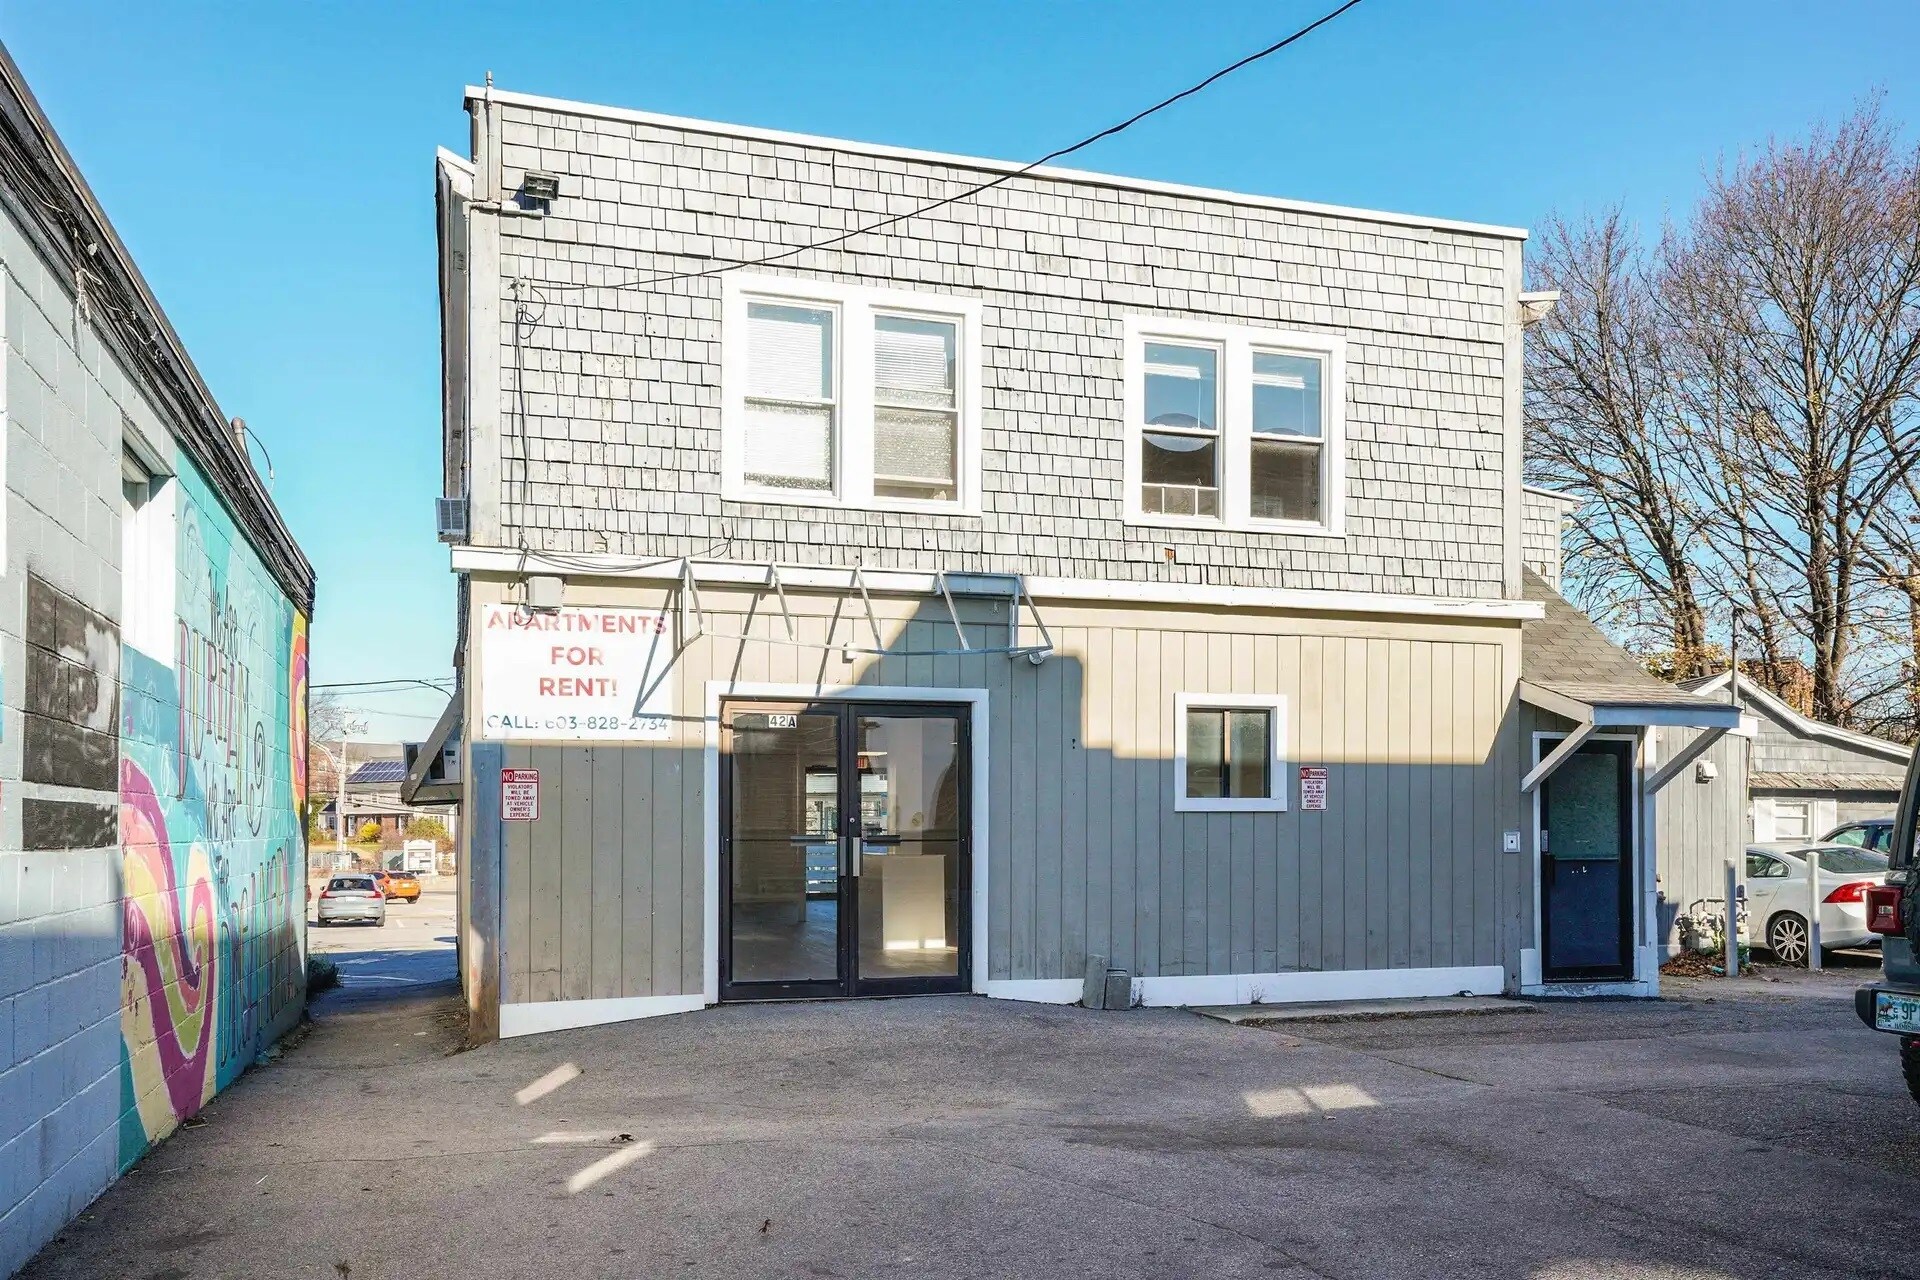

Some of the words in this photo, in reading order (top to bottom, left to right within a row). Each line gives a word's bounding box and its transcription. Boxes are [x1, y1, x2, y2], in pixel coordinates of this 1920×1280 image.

[487, 611, 667, 634] APARTMENTS
[551, 646, 604, 666] FOR
[539, 677, 617, 697] RENT!
[486, 714, 539, 730] CALL:
[770, 716, 795, 727] 42A
[503, 771, 514, 782] NO
[514, 773, 538, 781] PARKING
[1901, 1002, 1920, 1020] 9P
